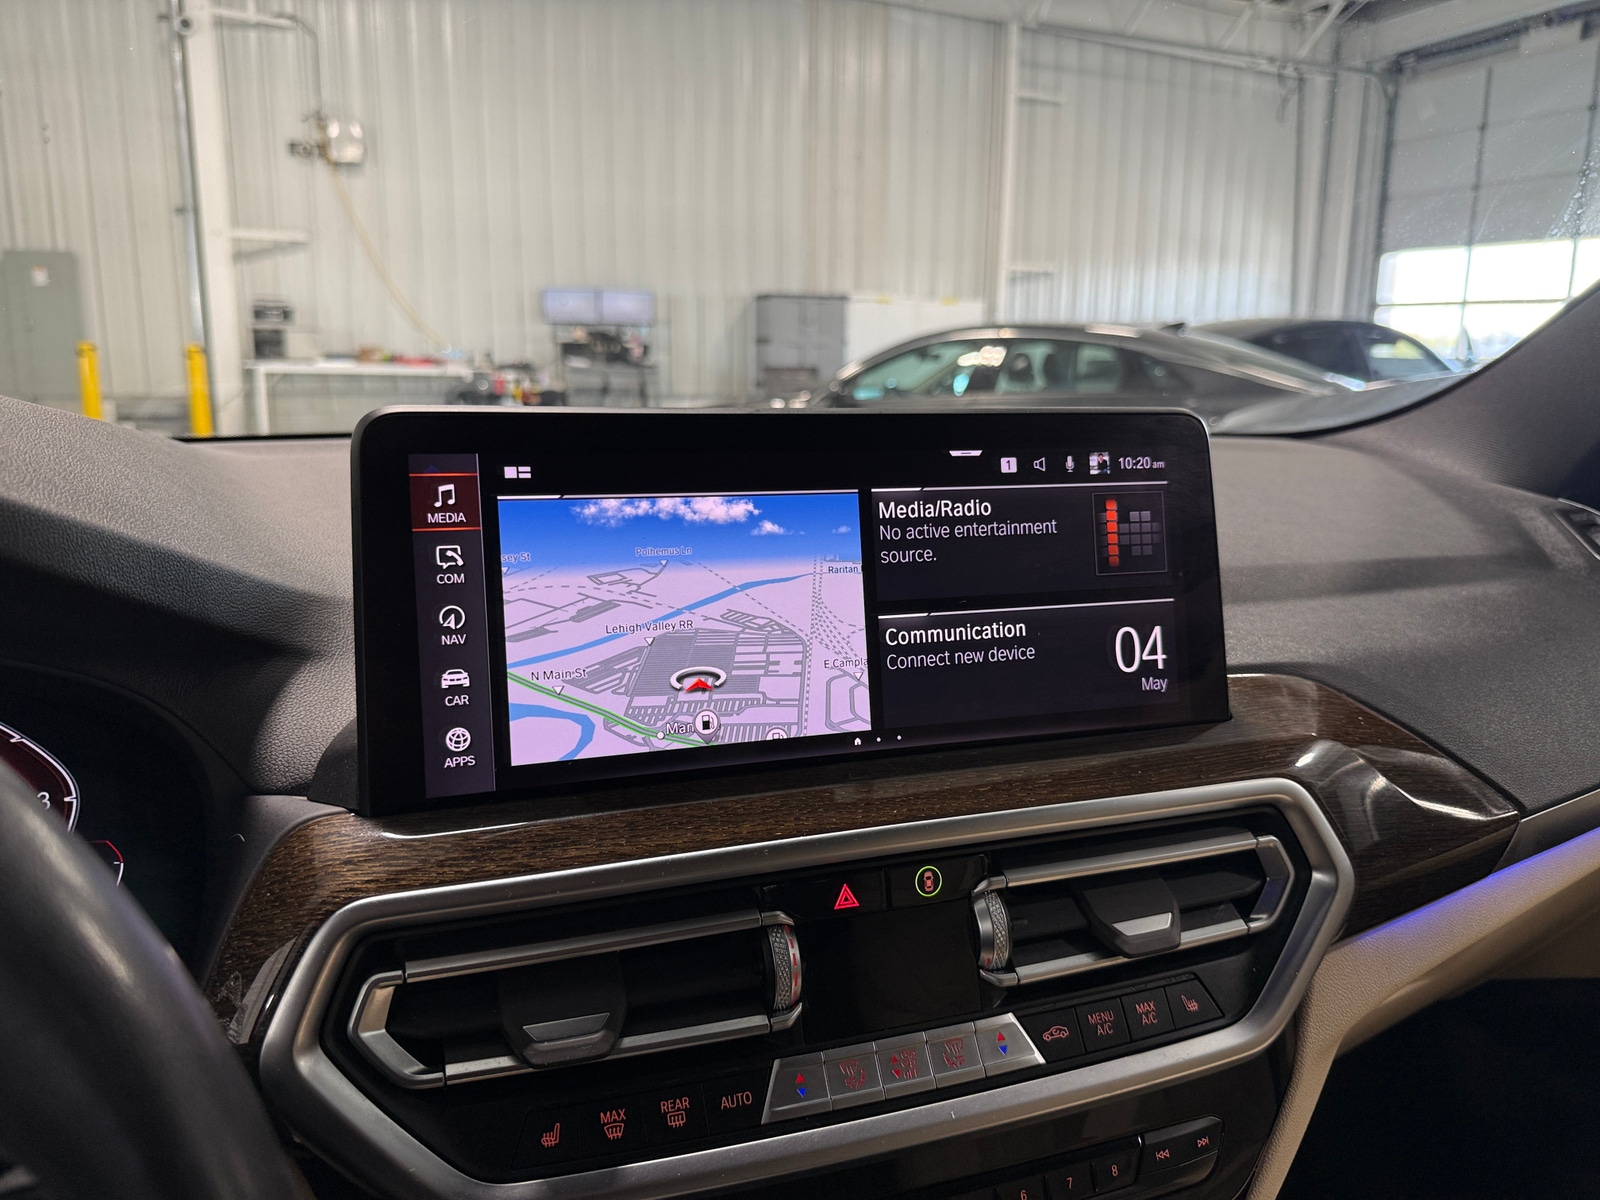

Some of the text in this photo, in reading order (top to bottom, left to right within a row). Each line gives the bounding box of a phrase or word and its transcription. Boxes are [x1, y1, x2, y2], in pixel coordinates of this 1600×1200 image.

[878, 499, 992, 519] Media/Radio
[427, 512, 467, 524] MEDIA
[879, 518, 1058, 541] No active entertainment
[520, 552, 531, 561] St
[635, 546, 692, 556] Polhemus Ln
[880, 547, 938, 564] source.
[828, 565, 859, 574] Raritan
[436, 573, 465, 584] COM
[605, 619, 694, 636] Lehigh Valley RR
[885, 621, 1027, 646] Communication
[441, 634, 467, 645] NAV
[1115, 625, 1168, 674] 04
[823, 659, 830, 669] E
[886, 645, 1036, 670] Connect new device
[531, 667, 587, 681] N Main St
[1141, 677, 1168, 693] May
[445, 694, 470, 707] CAR
[443, 755, 476, 769] APPS
[1135, 1000, 1156, 1014] MAX
[1087, 1010, 1115, 1025] MENU
[1142, 1012, 1158, 1026] A/C
[1097, 1022, 1114, 1036] A/C
[660, 1097, 690, 1113] REAR
[721, 1091, 753, 1110] AUTO
[600, 1108, 627, 1124] MAX
[1111, 1164, 1119, 1177] 8
[1066, 1177, 1073, 1190] 7
[1020, 1189, 1028, 1200] 6
